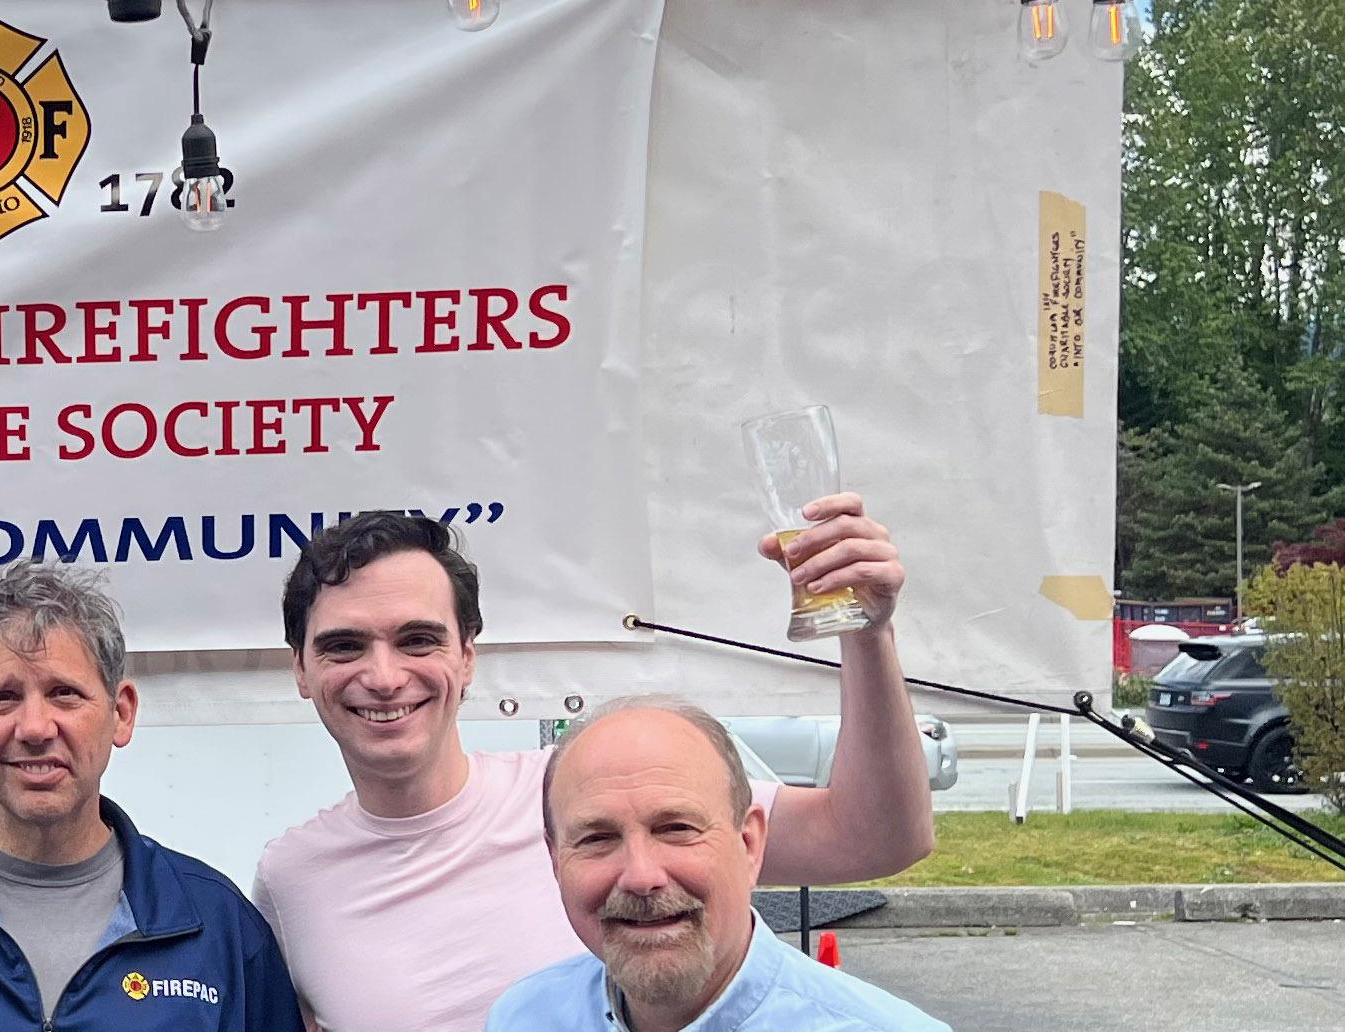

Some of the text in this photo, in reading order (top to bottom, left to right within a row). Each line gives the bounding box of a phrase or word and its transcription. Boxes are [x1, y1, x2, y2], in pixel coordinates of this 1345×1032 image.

[20, 116, 32, 144] 1918
[39, 100, 73, 159] F
[58, 395, 395, 461] SOCIETY
[152, 979, 219, 1004] FIREPAC
